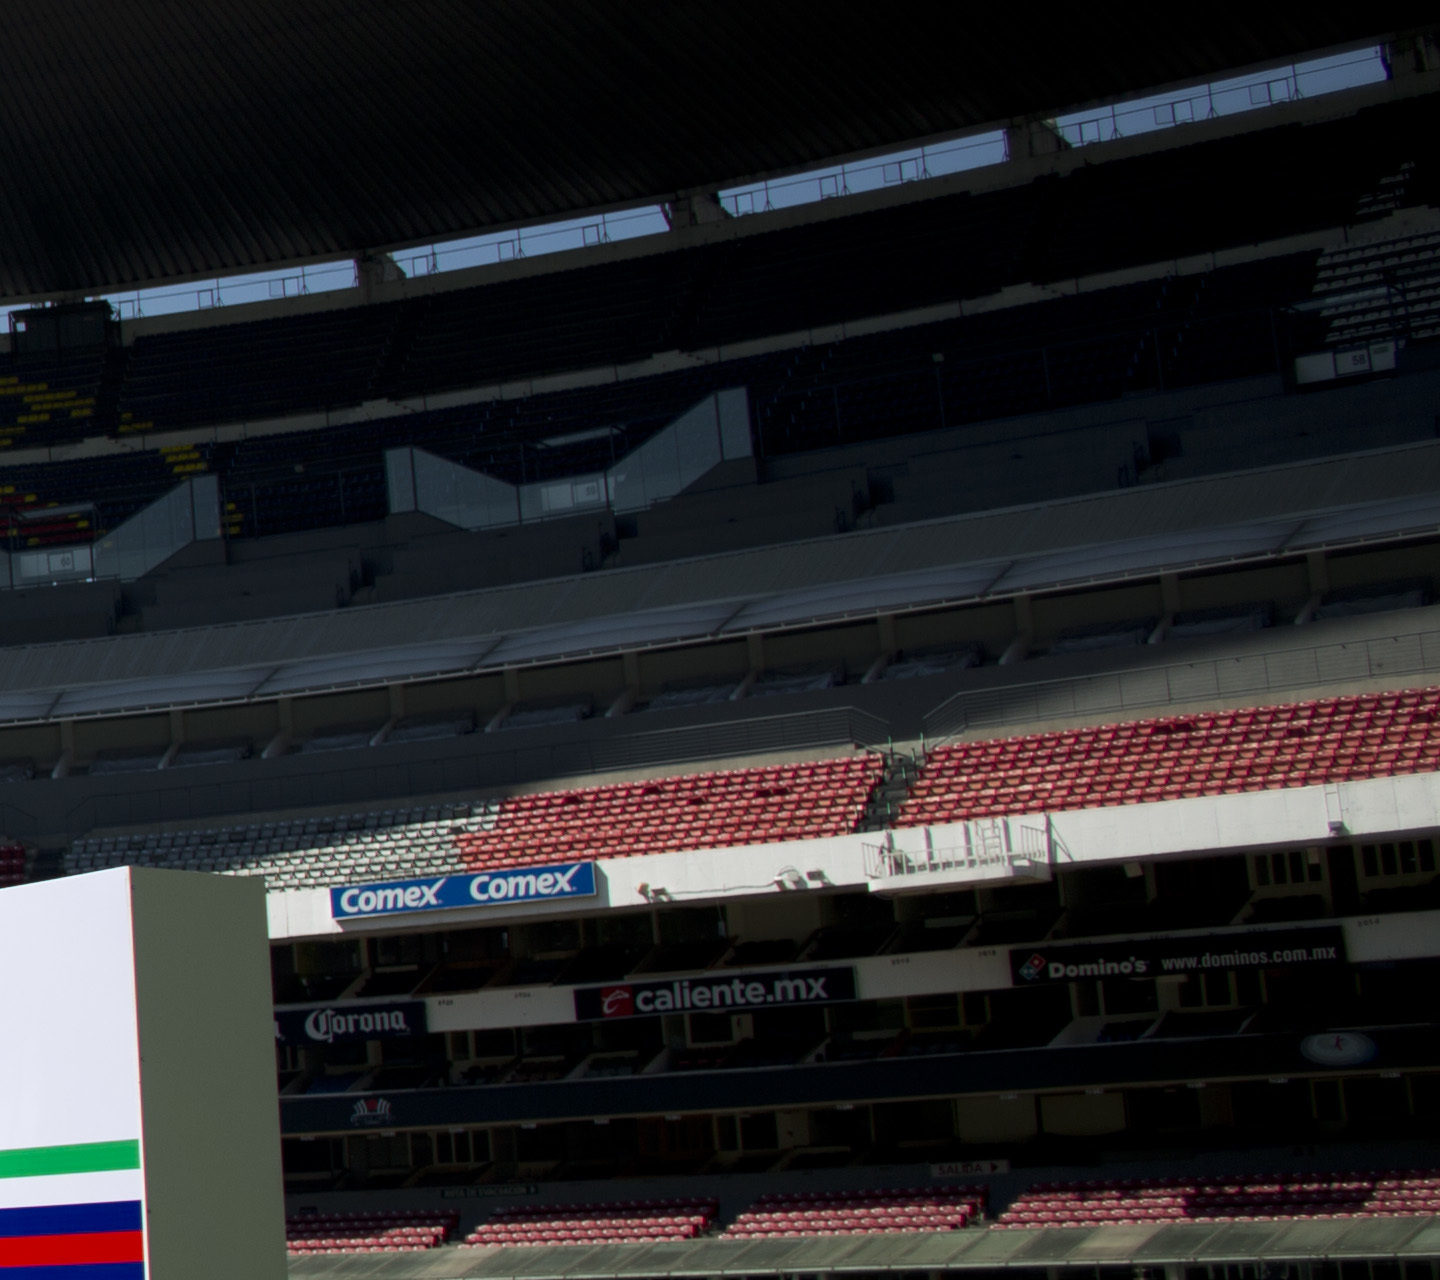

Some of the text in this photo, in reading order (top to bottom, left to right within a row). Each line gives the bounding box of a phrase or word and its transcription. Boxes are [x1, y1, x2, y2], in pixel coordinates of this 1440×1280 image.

[340, 863, 580, 915] Comex Comex
[1048, 944, 1336, 979] Domino's www.dominos.com.mx
[635, 976, 828, 1013] caliente.mx
[304, 1008, 409, 1043] Corona
[938, 1164, 983, 1176] SALIDA
